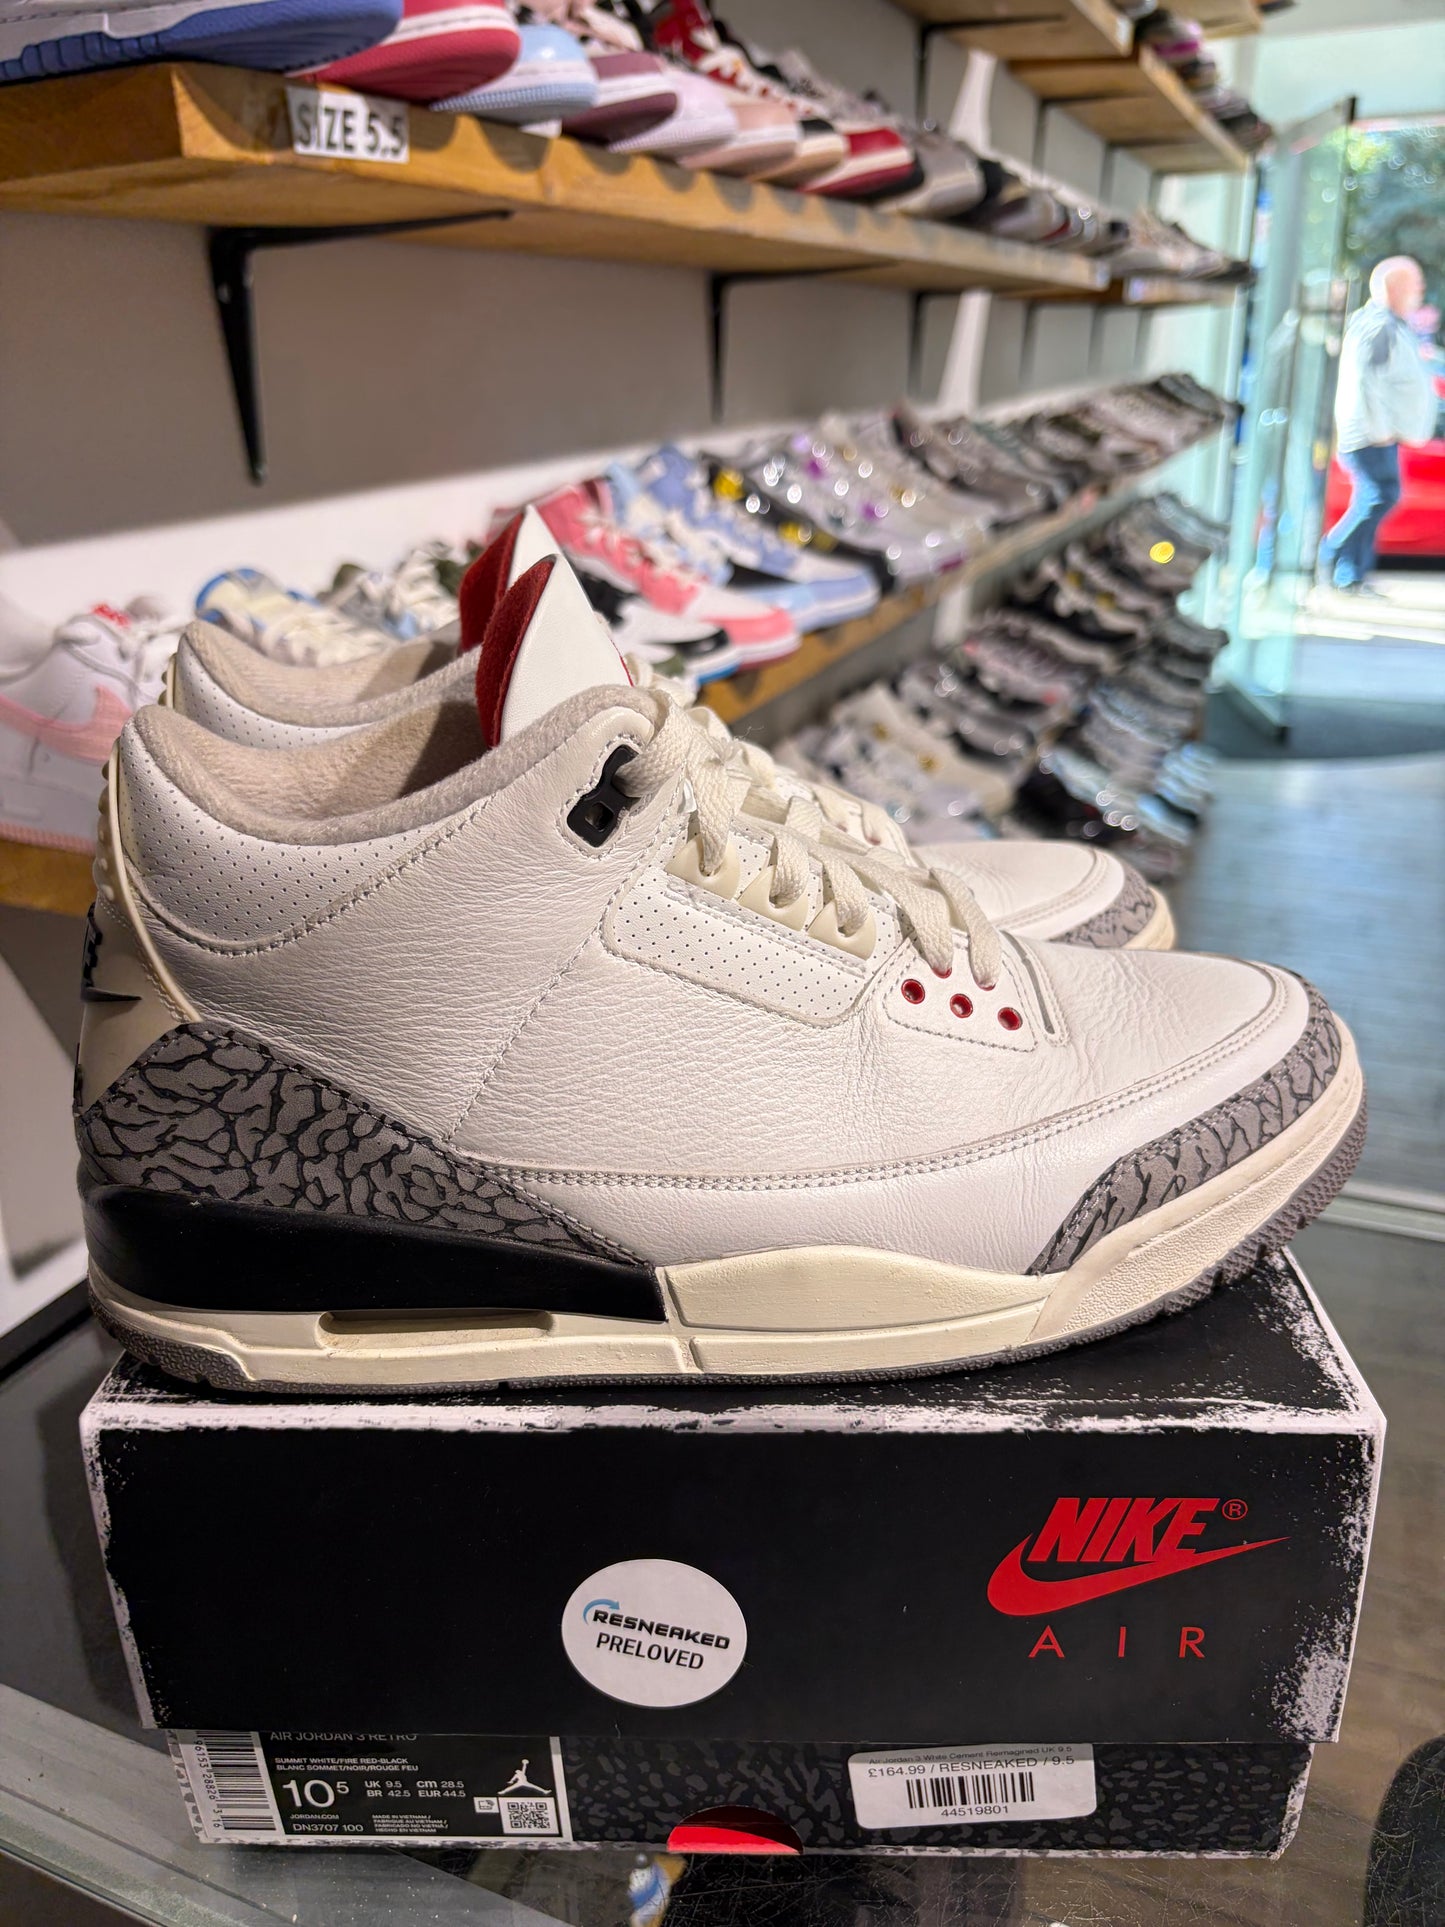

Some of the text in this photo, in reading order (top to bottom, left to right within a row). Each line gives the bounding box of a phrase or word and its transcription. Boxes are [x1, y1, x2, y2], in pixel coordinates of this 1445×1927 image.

[296, 102, 406, 156] SIZE 5.5
[1026, 1497, 1220, 1563] NIKE
[592, 1608, 731, 1650] RESNEAKED
[596, 1631, 704, 1670] PRELOVED
[269, 1731, 292, 1741] AIR
[295, 1732, 353, 1741] JORDAN
[949, 1751, 984, 1759] Cement
[986, 1748, 1040, 1757] Reimagined
[868, 1764, 926, 1778] £164.99
[939, 1757, 1038, 1773] RESNEAKED
[1052, 1755, 1075, 1766] 9.5
[364, 1780, 381, 1788] UK
[385, 1780, 402, 1788] 9.5
[416, 1780, 438, 1788] cm
[441, 1780, 465, 1788] 28.5
[418, 1790, 441, 1798] EUR
[442, 1790, 466, 1798] 44.5
[941, 1805, 1008, 1816] 44519801
[292, 1823, 364, 1832] DN3707 100
